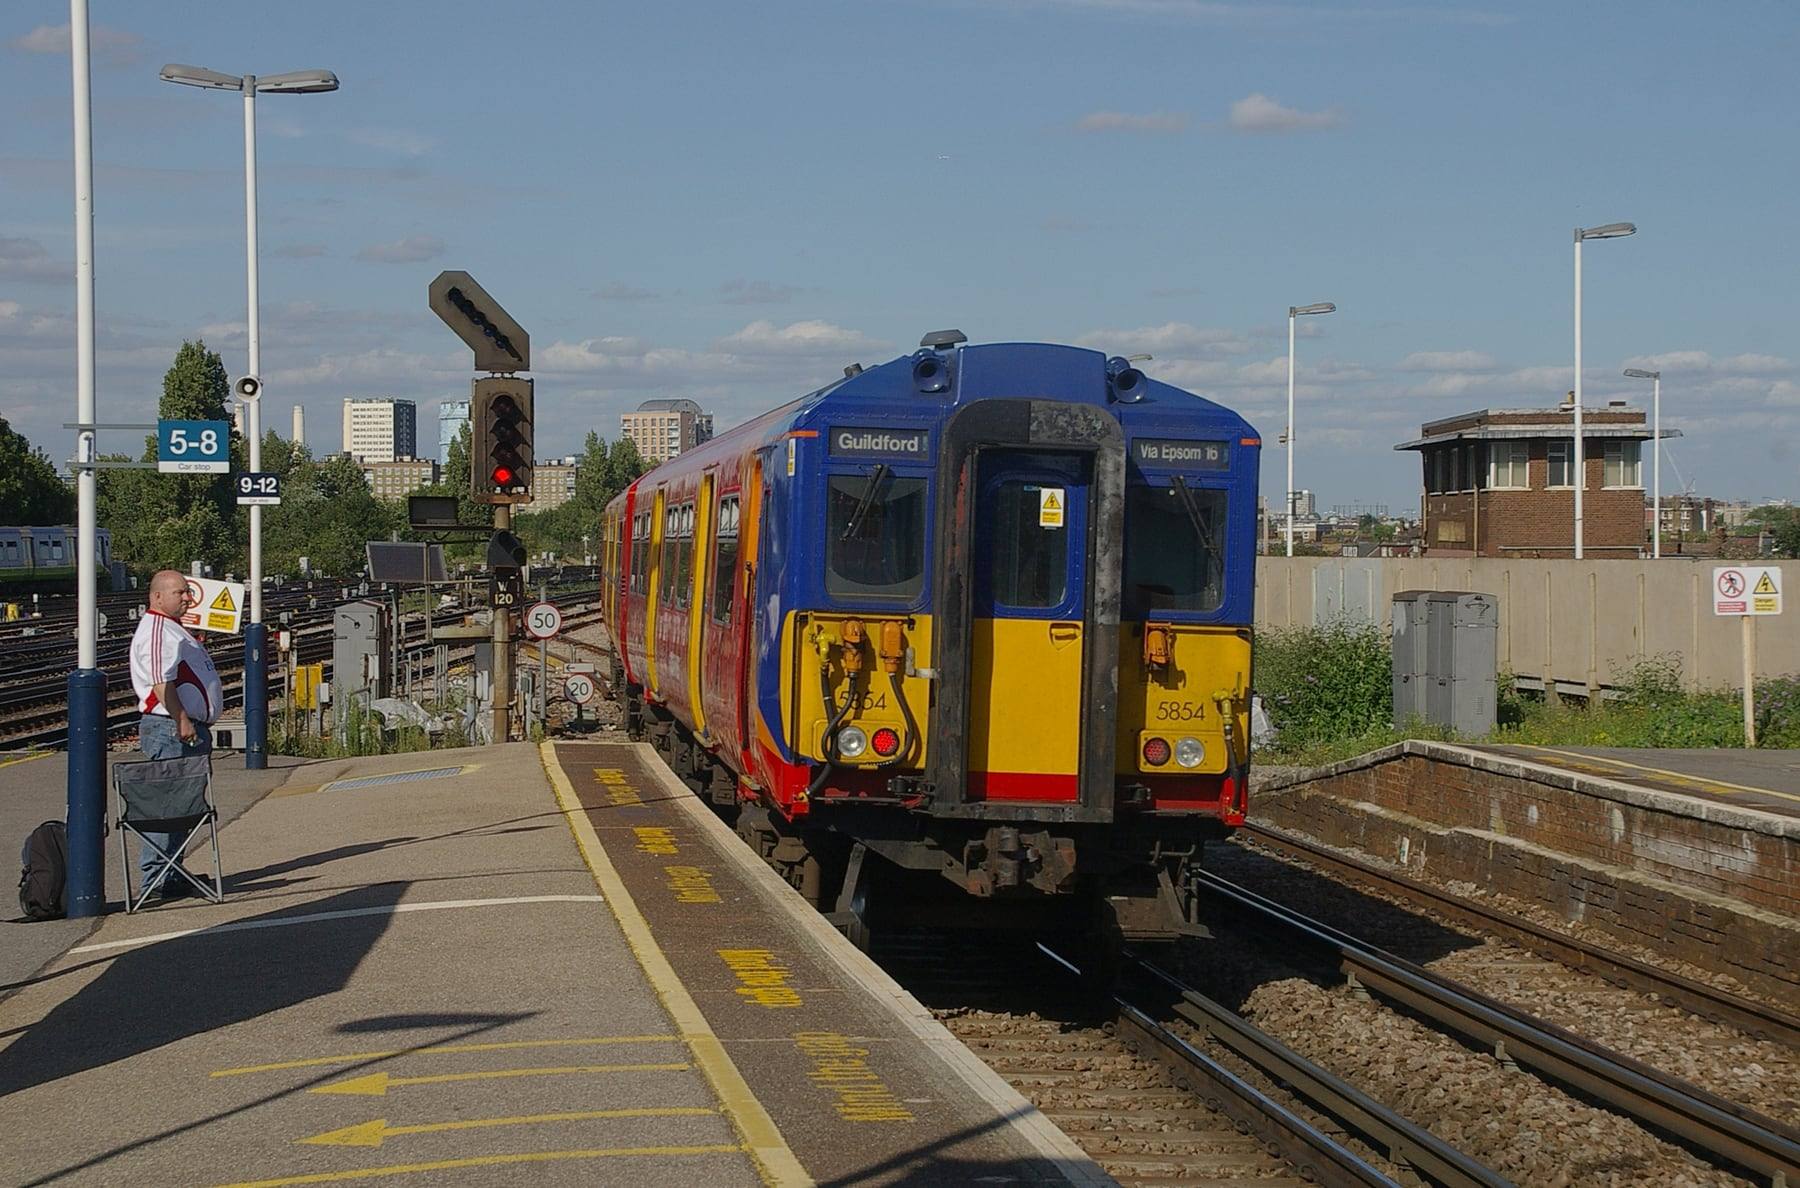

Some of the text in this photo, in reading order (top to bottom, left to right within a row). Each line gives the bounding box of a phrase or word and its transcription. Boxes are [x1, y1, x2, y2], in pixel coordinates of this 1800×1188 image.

[169, 429, 218, 455] 5-8
[838, 433, 919, 452] Guildford
[1140, 444, 1159, 459] Via
[1161, 445, 1202, 462] Epsom
[178, 462, 192, 471] Car
[240, 477, 278, 493] 9-12
[494, 593, 514, 605] 120
[533, 612, 556, 629] 50
[570, 682, 589, 696] 20
[1156, 701, 1206, 721] 5854
